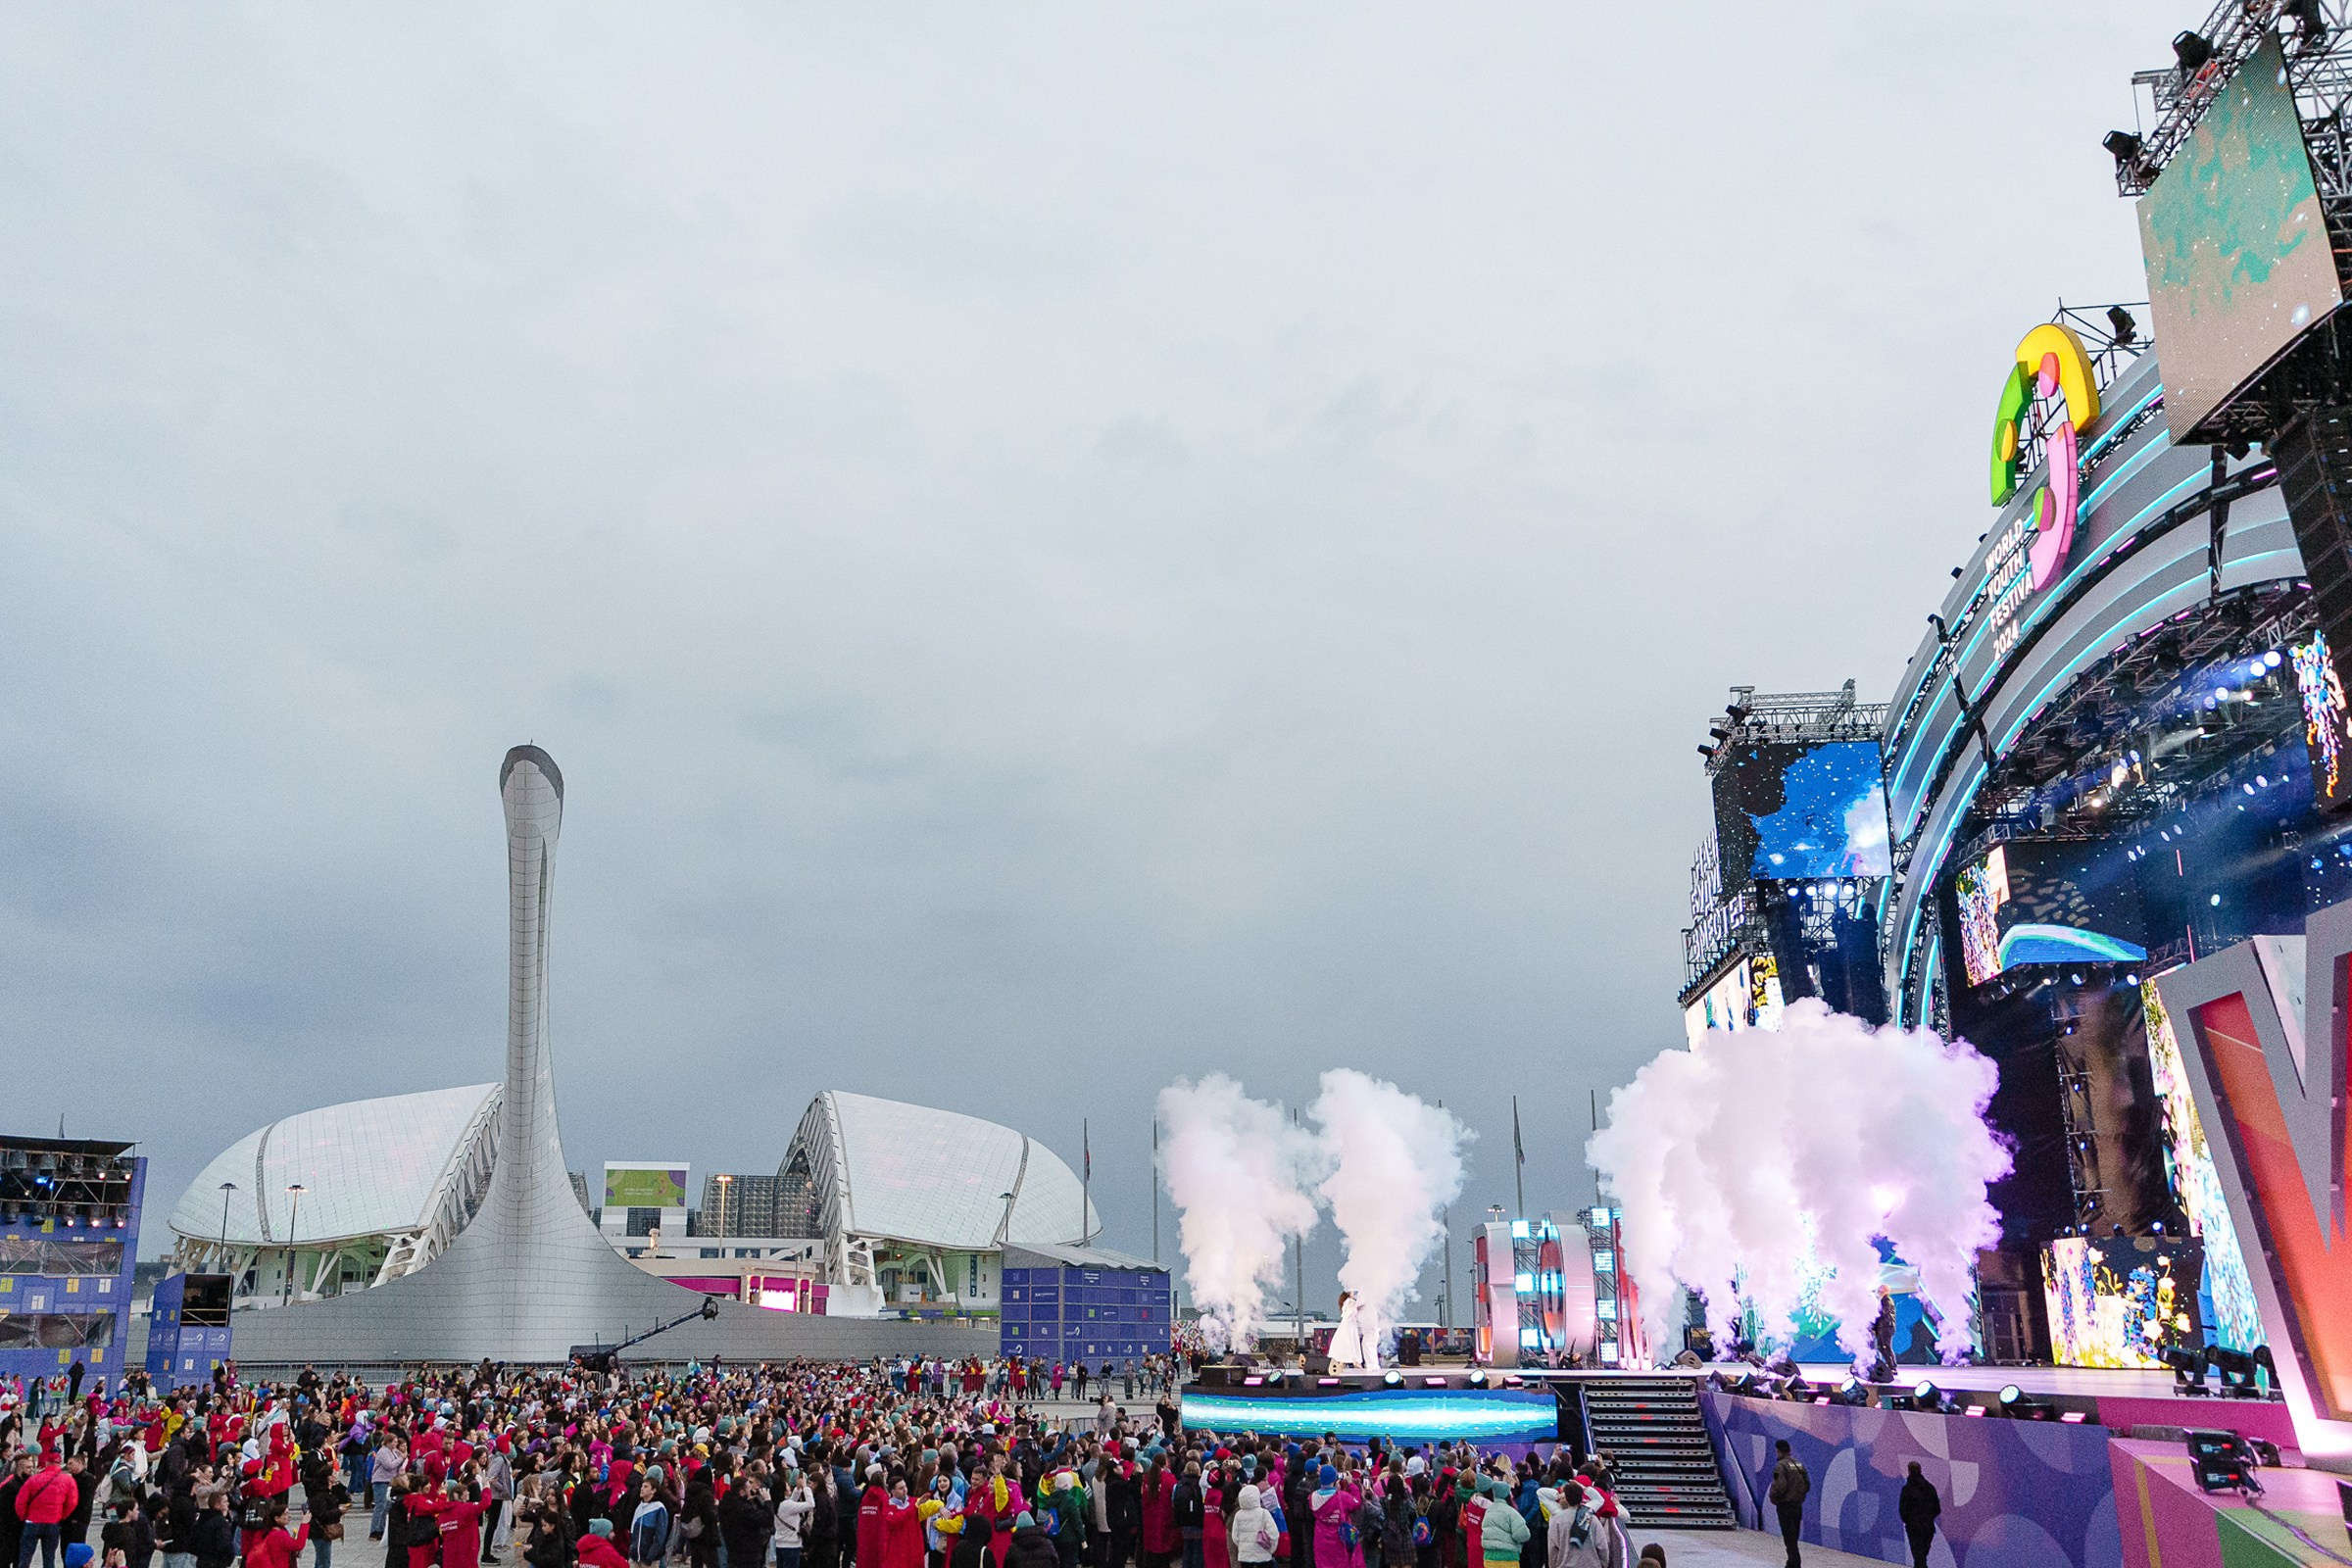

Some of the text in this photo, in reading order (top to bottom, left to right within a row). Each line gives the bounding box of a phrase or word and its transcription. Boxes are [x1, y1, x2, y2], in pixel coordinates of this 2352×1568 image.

[1984, 517, 2024, 573] WORLD
[1986, 548, 2025, 603] YOUTH
[1989, 570, 2034, 632] FESTIVA
[1993, 618, 2019, 661] 2024
